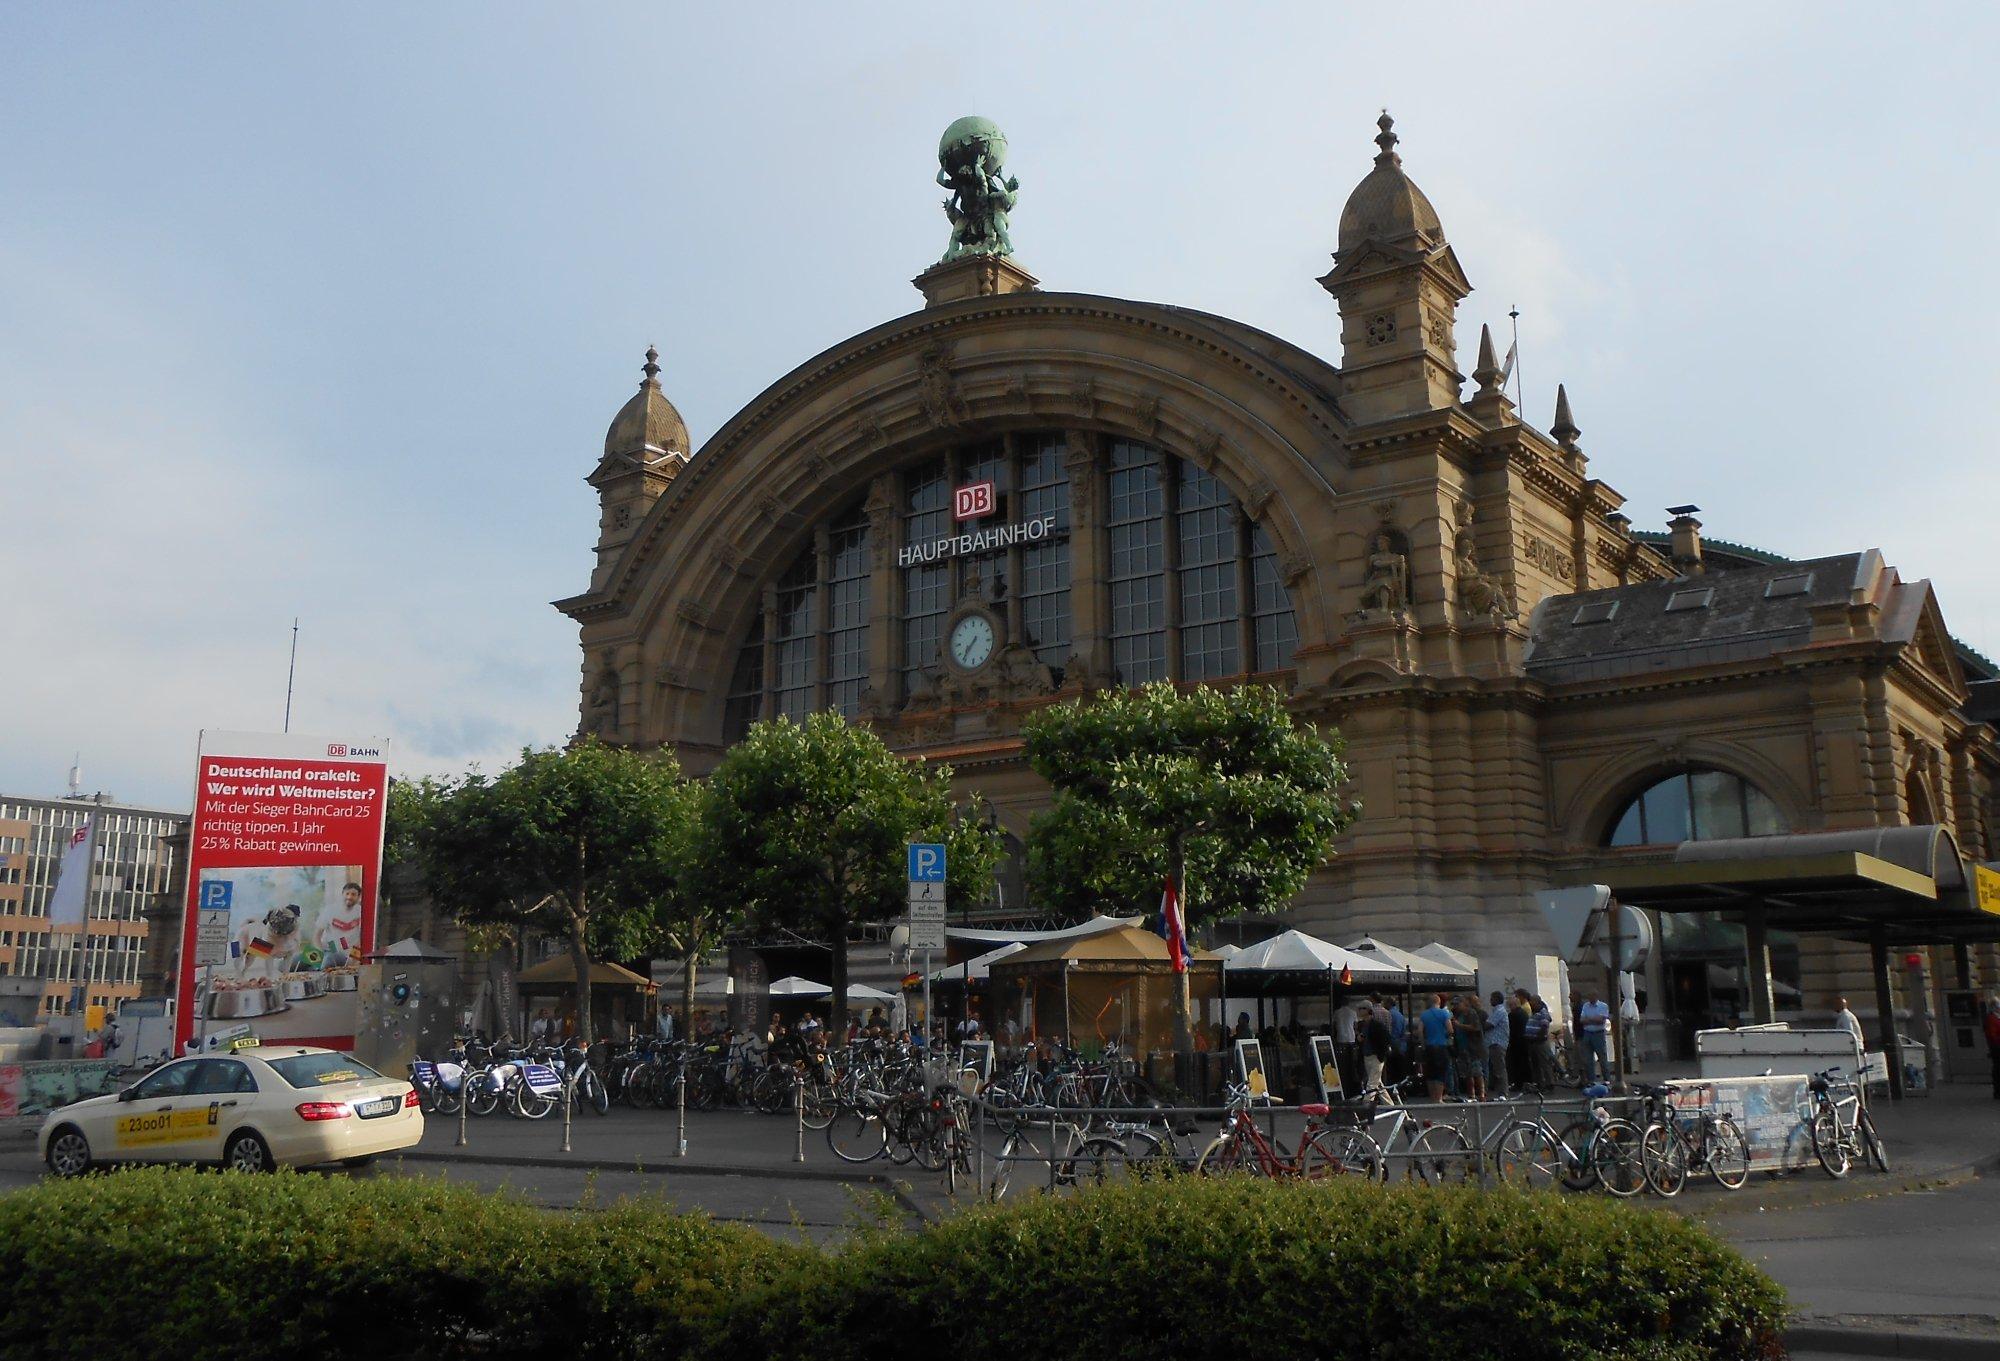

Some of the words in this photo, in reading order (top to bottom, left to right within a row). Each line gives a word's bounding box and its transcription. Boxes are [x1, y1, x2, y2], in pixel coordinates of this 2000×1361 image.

[960, 488, 987, 515] DB
[899, 517, 1055, 566] HAUPTBAHNHOF
[330, 746, 344, 755] DB
[350, 748, 379, 756] BAHN
[208, 764, 301, 780] Deutschland
[305, 769, 360, 782] orakelt:
[207, 783, 238, 795] Wer
[242, 784, 275, 796] wird
[279, 785, 375, 800] Weltmeister?
[205, 801, 229, 813] Mit
[229, 802, 249, 813] der
[253, 803, 290, 818] Sieger
[293, 804, 352, 817] BahnCard
[355, 806, 370, 817] 25
[203, 820, 241, 834] richtig
[246, 821, 289, 835] tippen.
[293, 822, 298, 833] 1
[301, 822, 325, 836] Jahr
[234, 838, 276, 851] Rabatt
[280, 840, 342, 853] gewinnen.
[918, 849, 937, 877] P
[208, 883, 226, 906] P
